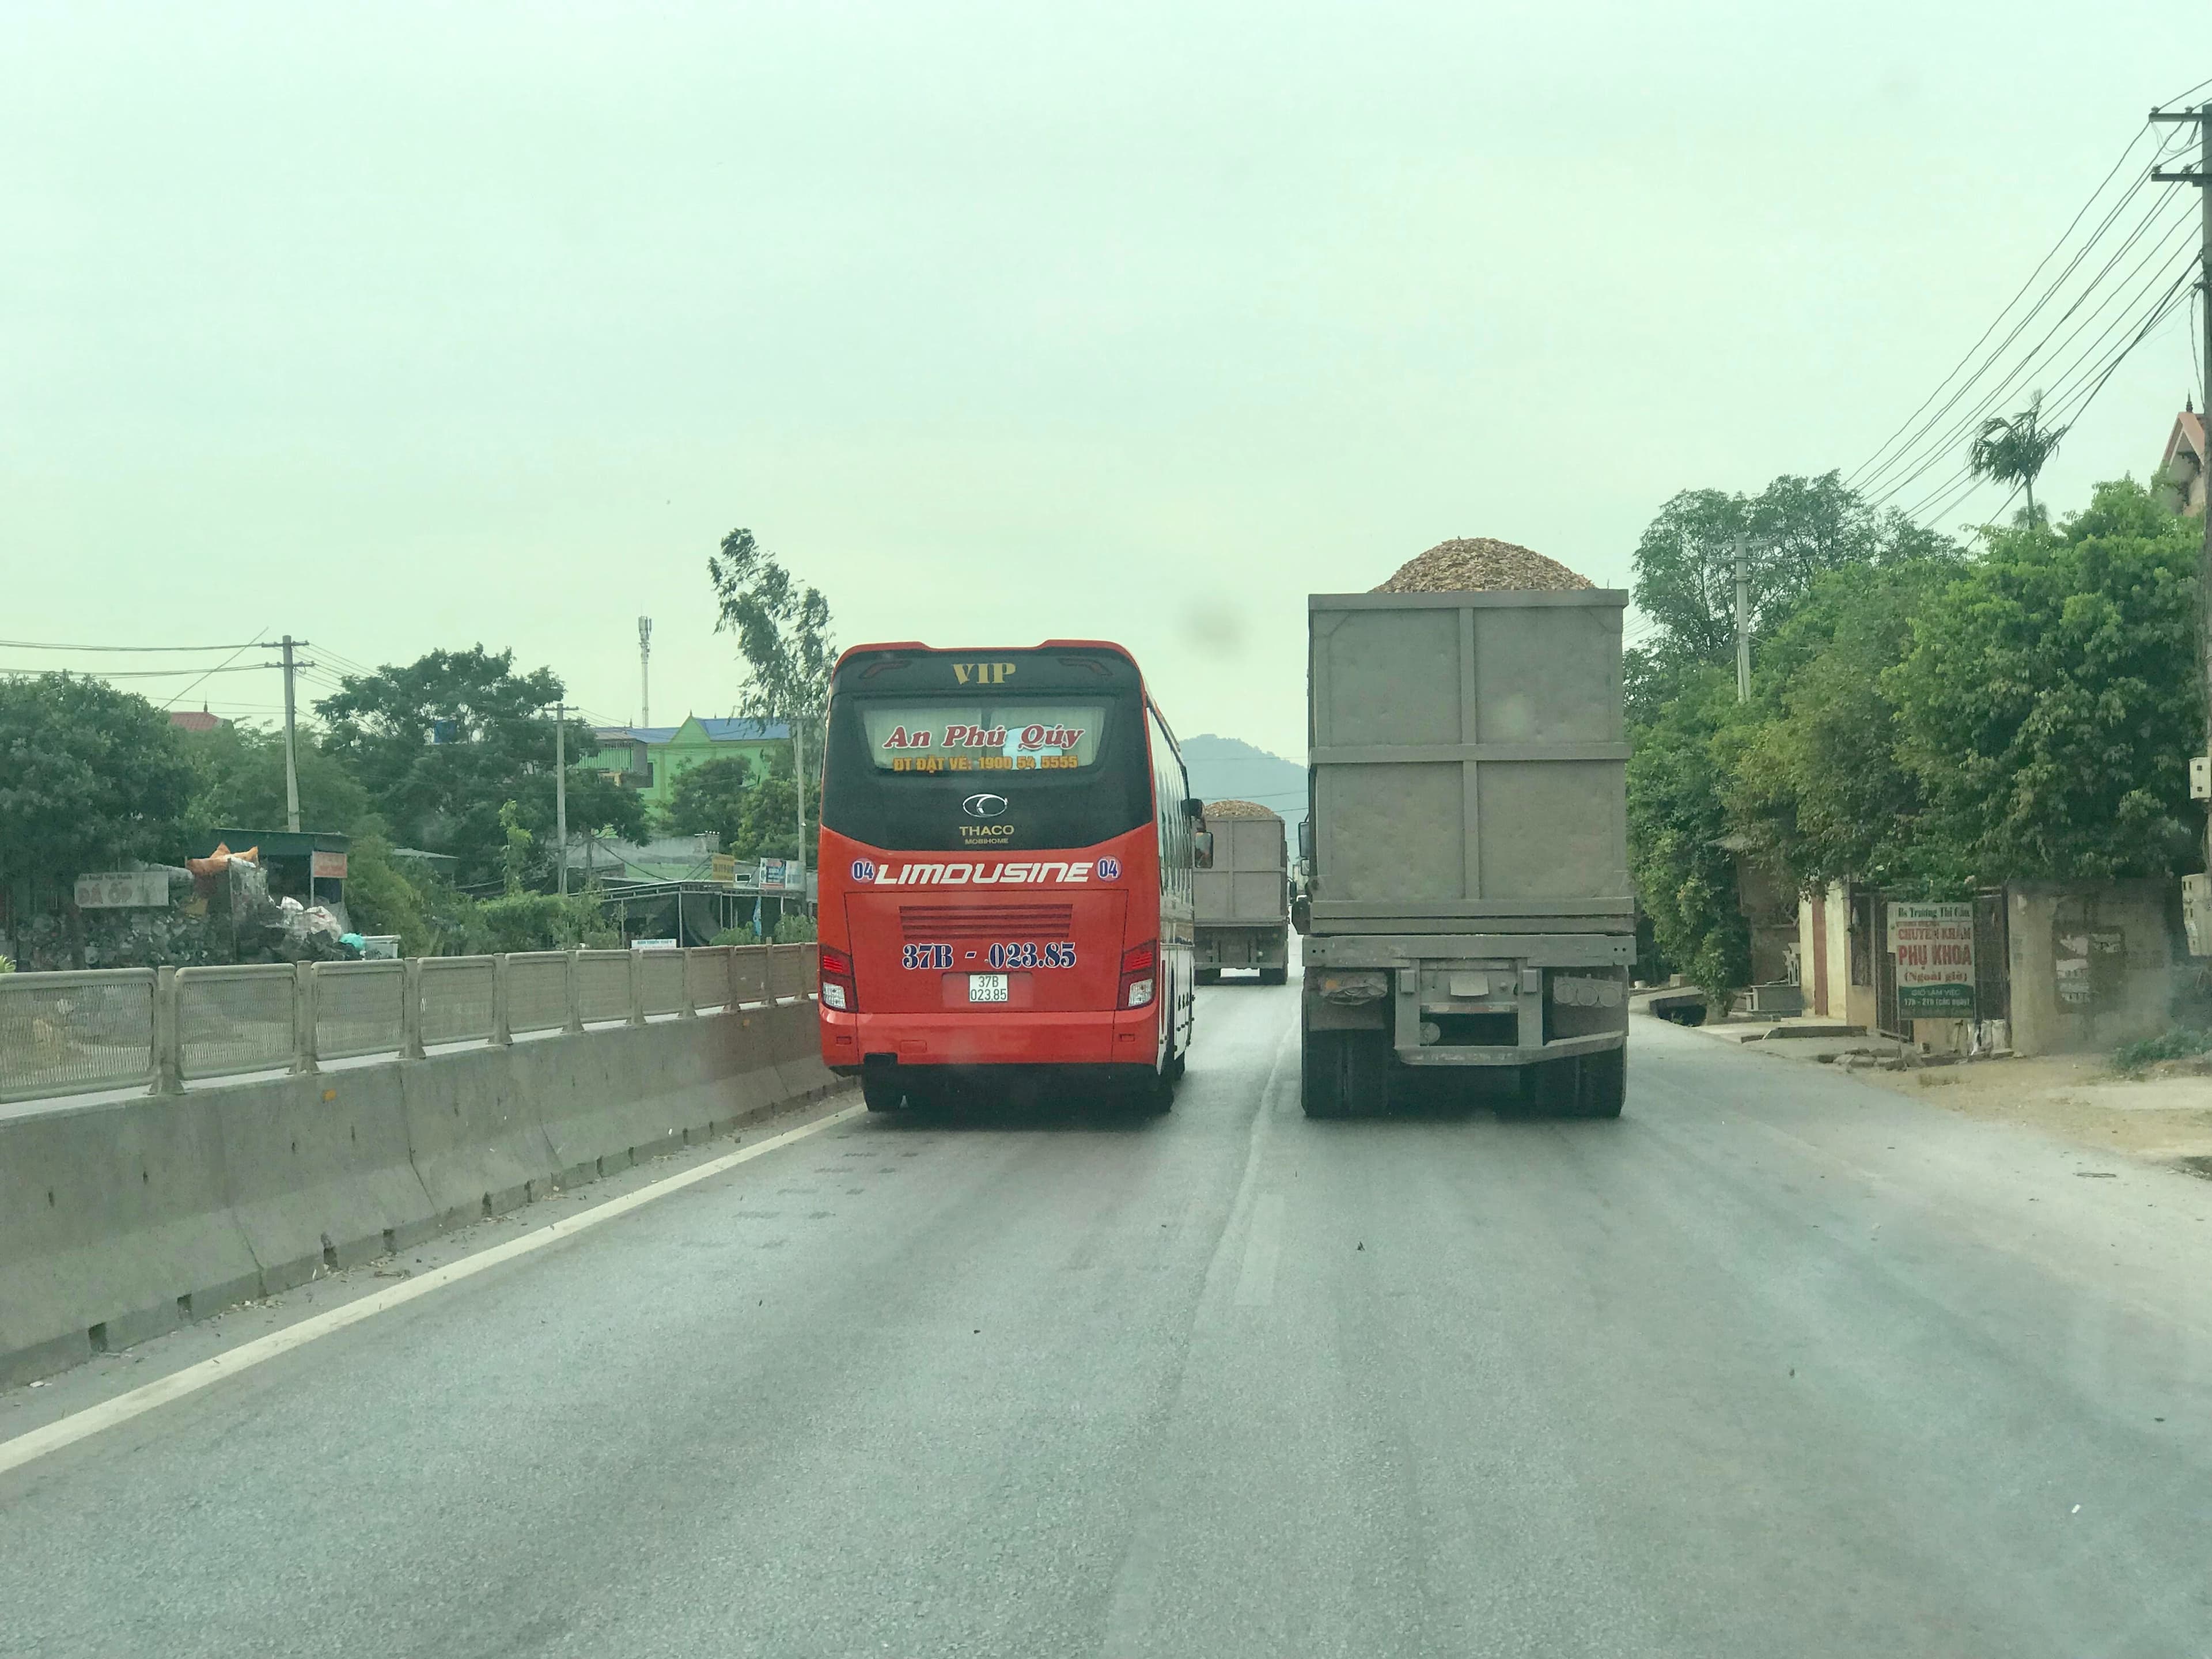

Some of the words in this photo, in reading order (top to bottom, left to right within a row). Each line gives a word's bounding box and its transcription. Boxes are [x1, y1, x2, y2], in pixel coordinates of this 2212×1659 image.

[950, 662, 1016, 684] VIP
[882, 725, 931, 748] An
[941, 724, 1007, 747] Phú
[1018, 724, 1085, 750] Qúy
[978, 756, 1013, 770] 1900
[1016, 756, 1036, 770] 54
[1041, 755, 1078, 769] 5555
[959, 825, 1014, 836] THACO
[852, 860, 875, 880] 04
[874, 862, 1093, 884] LIMOUSINE
[1097, 859, 1118, 879] 04
[902, 942, 954, 969] 37B
[988, 941, 1076, 969] 023.85
[1899, 945, 1927, 969] PHỤ
[1932, 945, 1972, 965] KHOA
[978, 976, 999, 988] 37B
[970, 988, 1007, 1001] 023.85
